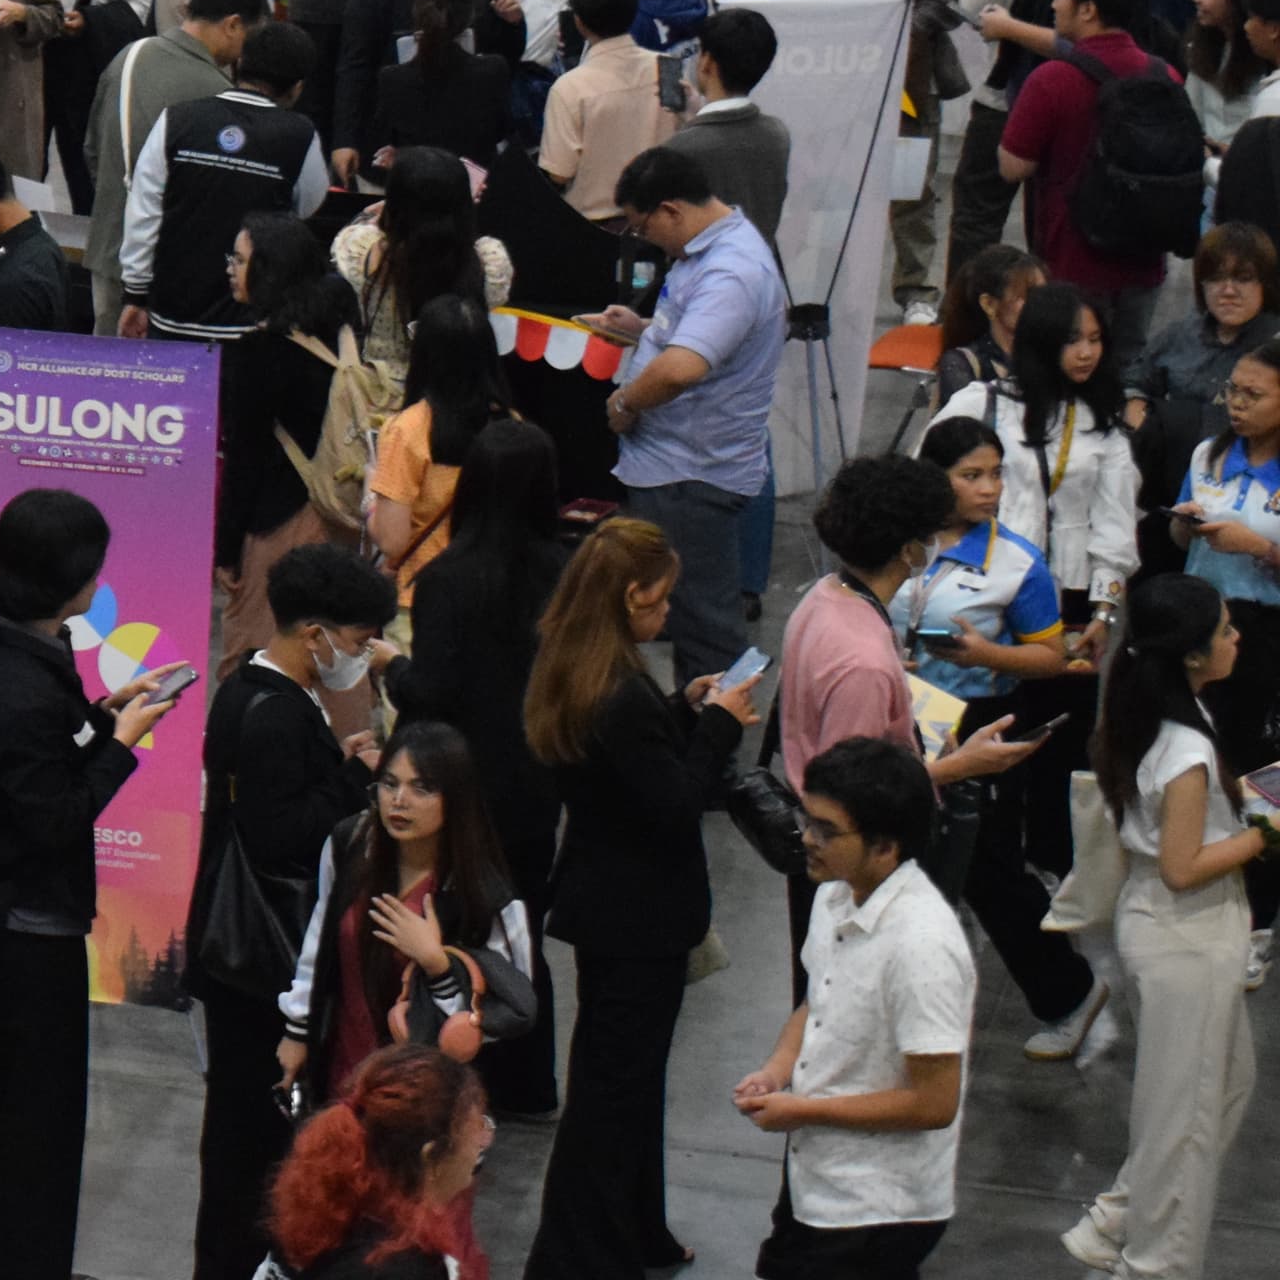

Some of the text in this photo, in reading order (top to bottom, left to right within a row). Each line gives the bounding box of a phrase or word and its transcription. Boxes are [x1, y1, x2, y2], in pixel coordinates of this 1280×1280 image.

[17, 362, 37, 371] NCR
[39, 363, 87, 376] ALLIANCE
[87, 367, 102, 376] OF
[104, 368, 130, 378] DOST
[132, 371, 185, 383] SCHOLARS
[94, 827, 142, 846] ESCO
